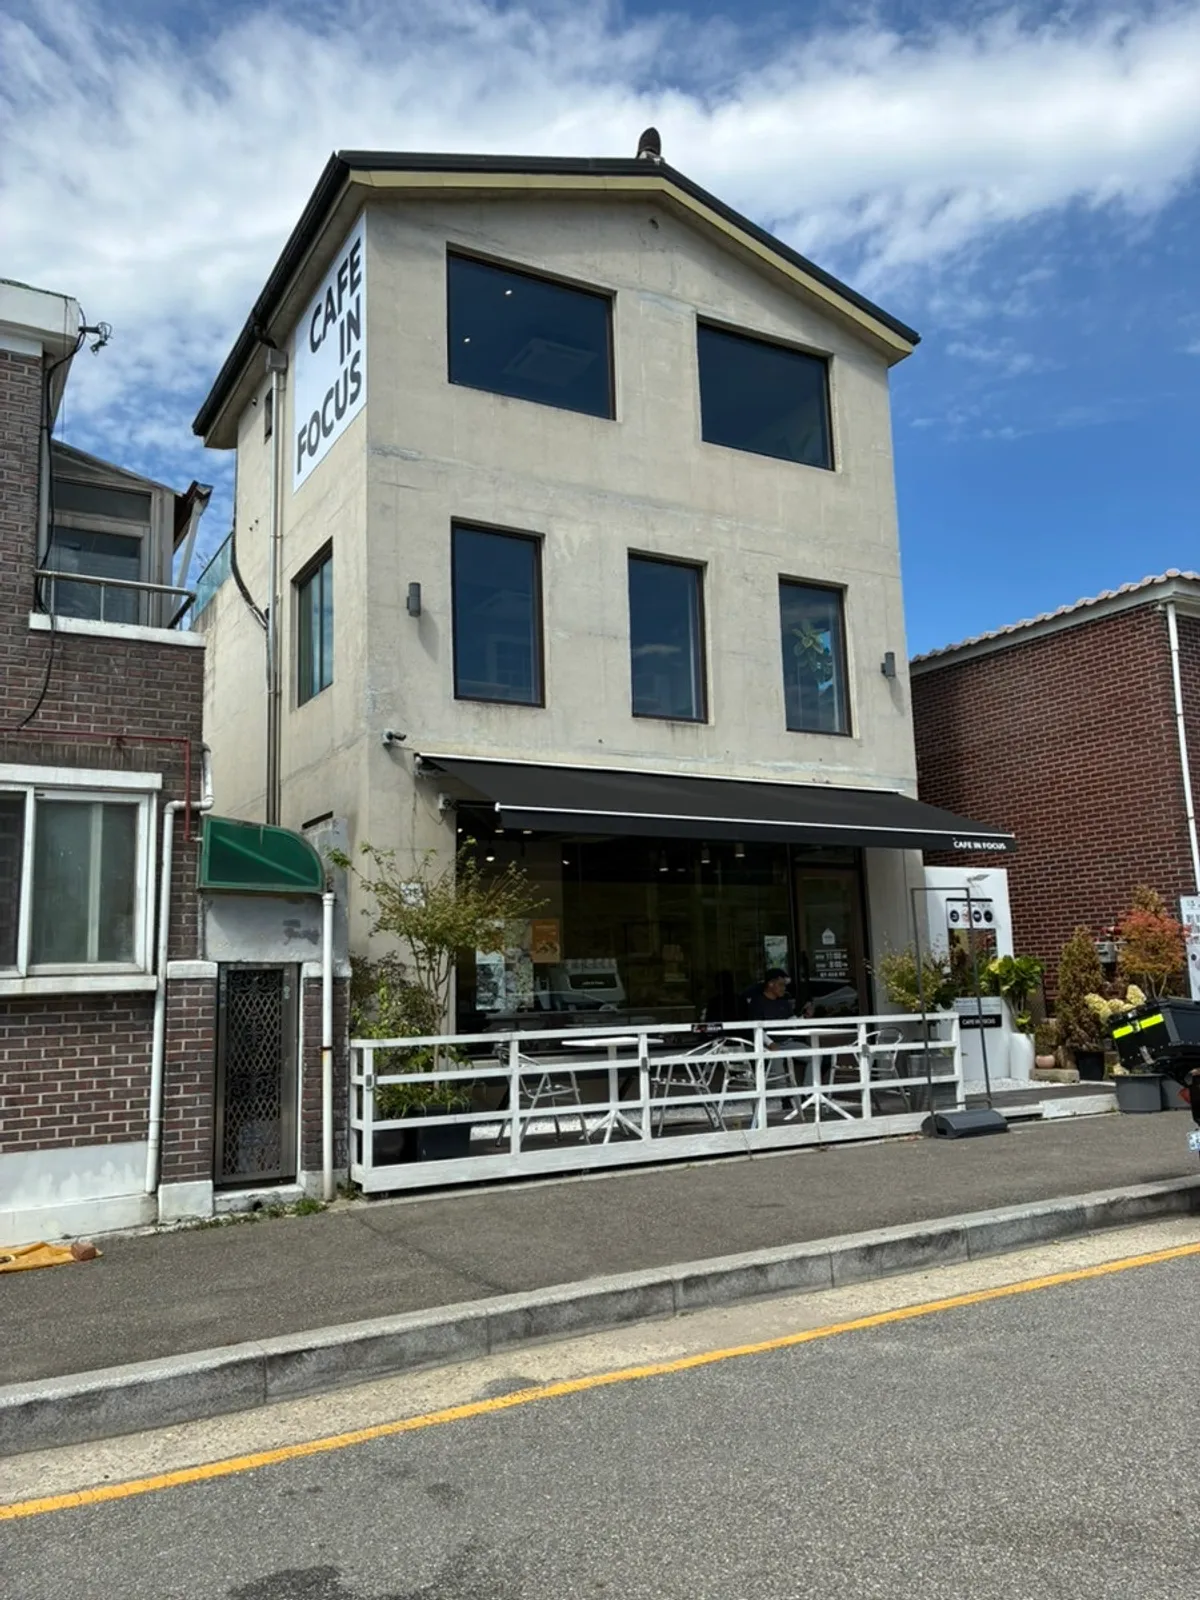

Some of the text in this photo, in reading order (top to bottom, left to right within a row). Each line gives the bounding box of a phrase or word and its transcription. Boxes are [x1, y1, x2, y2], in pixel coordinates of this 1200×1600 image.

[309, 236, 361, 353] CAFE
[339, 293, 361, 366] IN
[297, 350, 362, 475] FOCUS
[953, 840, 1007, 850] CAFE IN FOCUS
